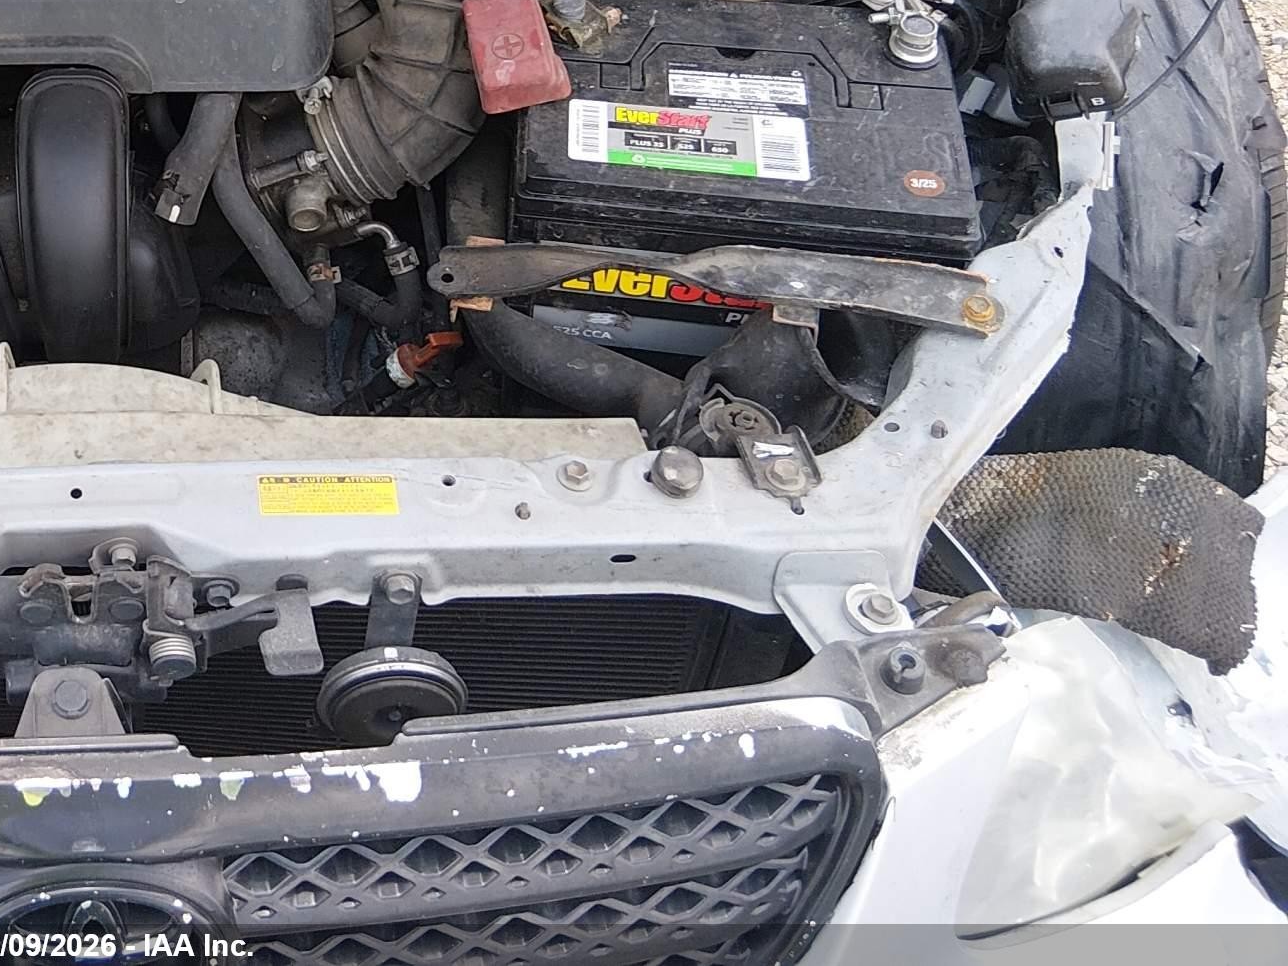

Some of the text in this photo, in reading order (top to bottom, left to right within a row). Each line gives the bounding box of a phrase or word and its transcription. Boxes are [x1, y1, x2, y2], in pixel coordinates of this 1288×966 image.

[615, 106, 710, 129] EverStart
[678, 127, 702, 135] PLUS
[909, 178, 938, 189] 3/25
[582, 329, 612, 340] CCA
[296, 476, 338, 484] CAUTION
